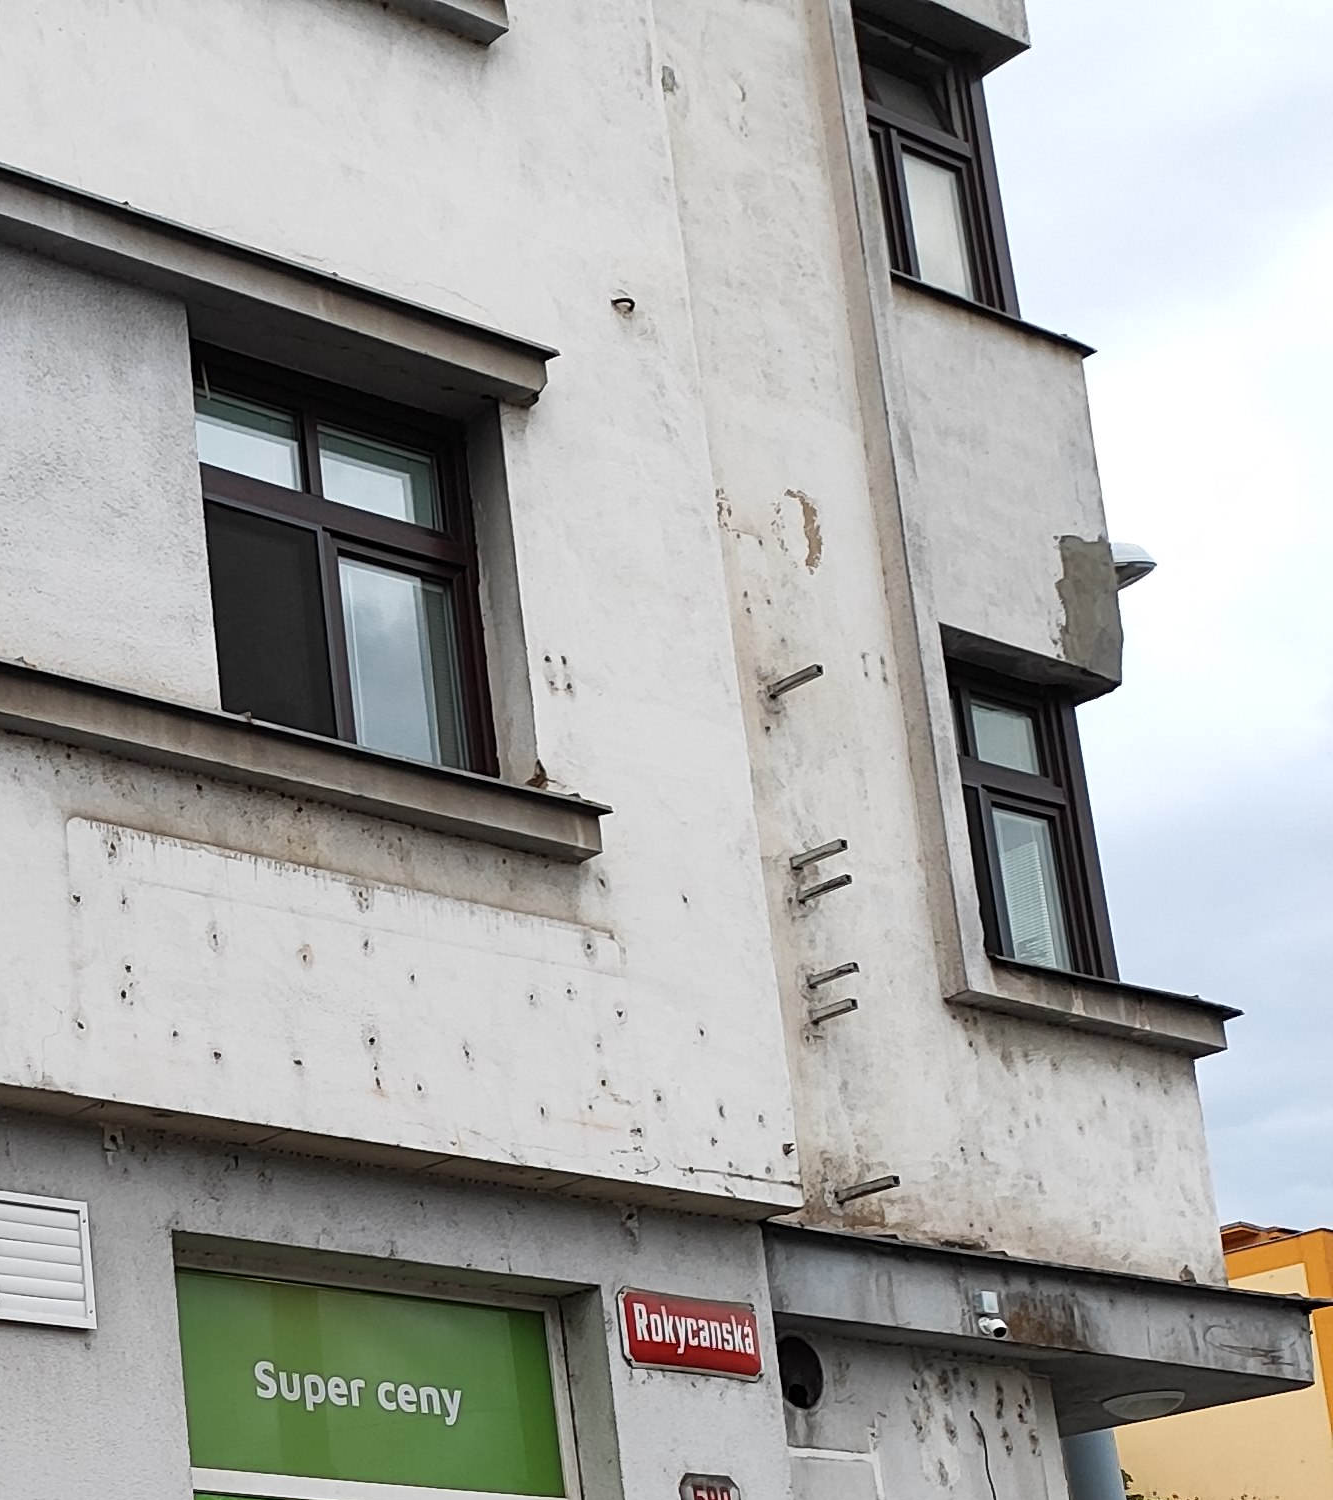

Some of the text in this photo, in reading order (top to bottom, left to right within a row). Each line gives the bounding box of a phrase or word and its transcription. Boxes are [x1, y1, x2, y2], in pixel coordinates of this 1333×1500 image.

[633, 1302, 756, 1355] Rokycanská
[254, 1360, 462, 1426] Super ceny
